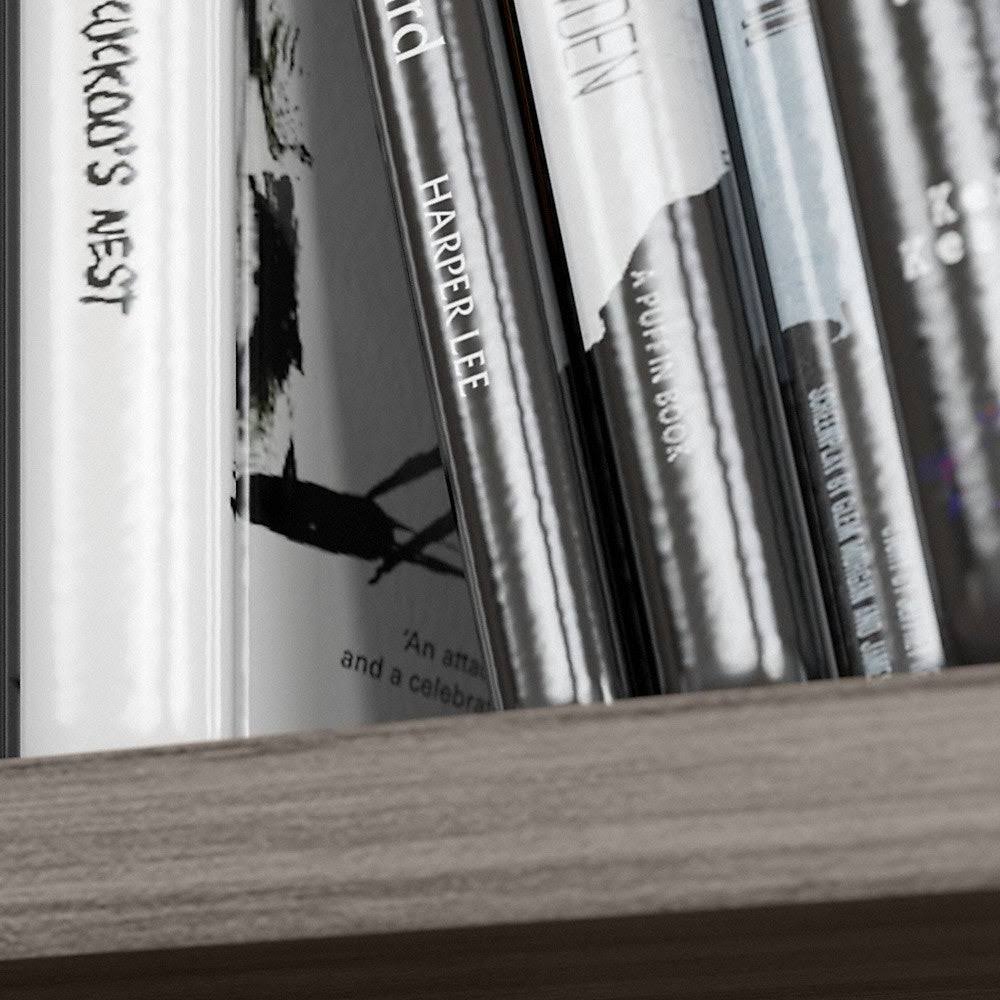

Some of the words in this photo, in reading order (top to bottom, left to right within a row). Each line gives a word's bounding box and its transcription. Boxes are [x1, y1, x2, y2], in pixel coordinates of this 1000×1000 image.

[382, 0, 446, 63] rd
[80, 209, 138, 315] NEST
[420, 173, 474, 320] HARPER
[451, 325, 490, 398] LEE
[653, 388, 693, 462] BOOK
[341, 650, 384, 679] and
[390, 666, 402, 686] a
